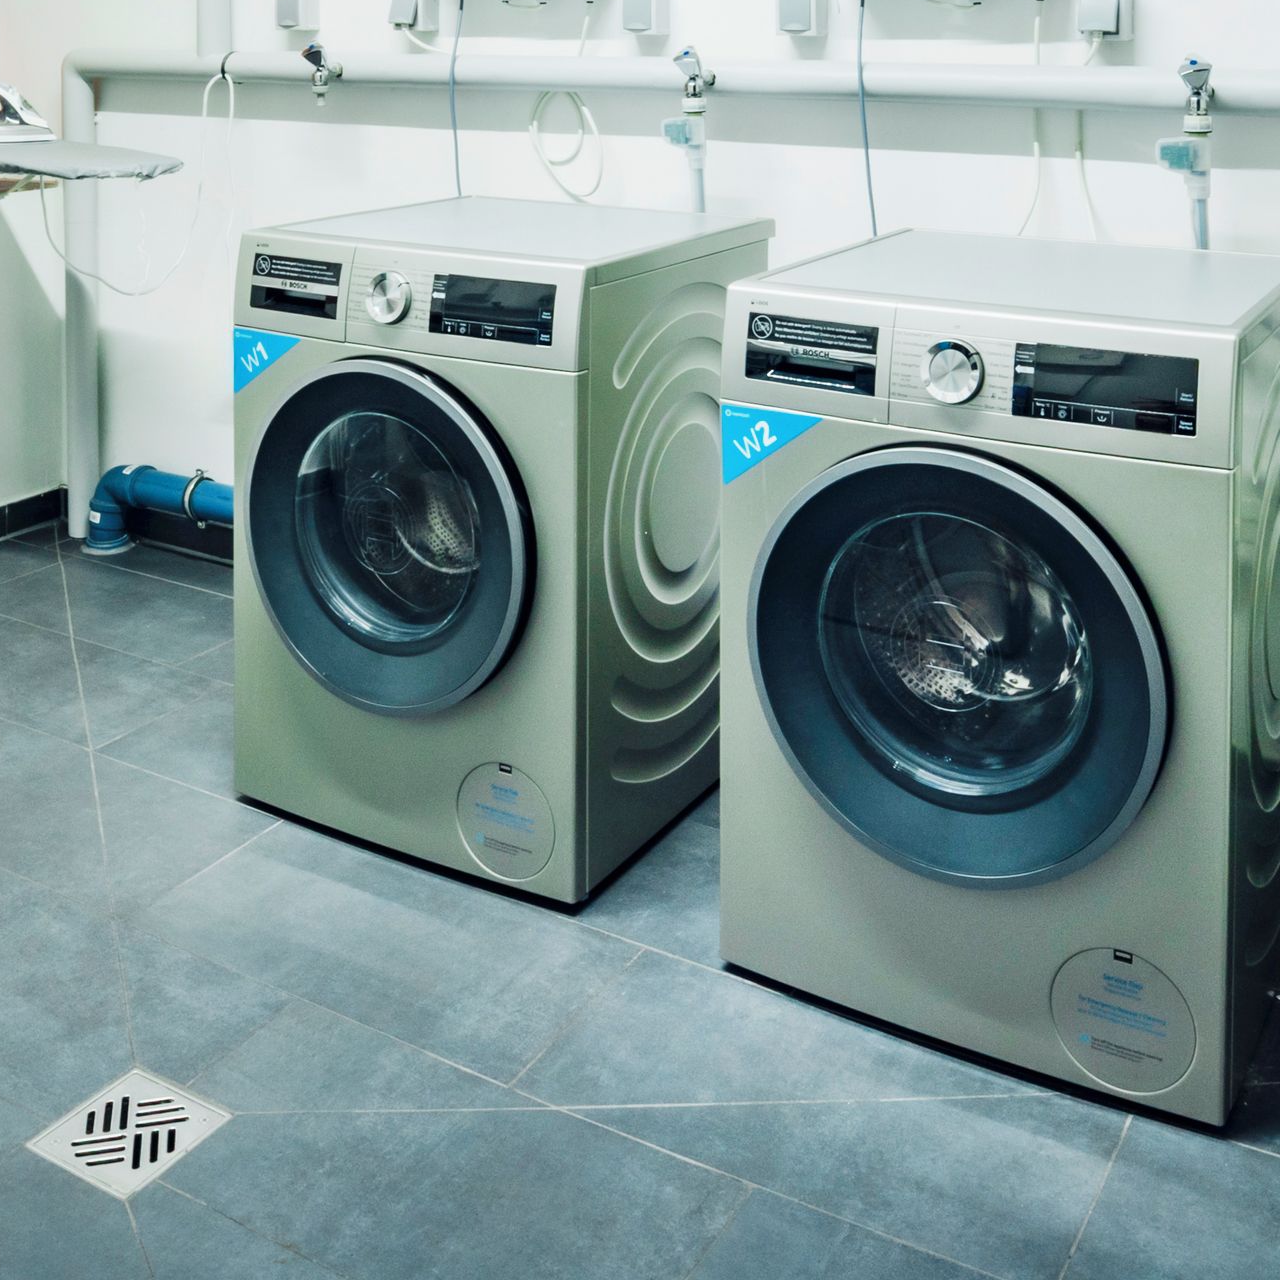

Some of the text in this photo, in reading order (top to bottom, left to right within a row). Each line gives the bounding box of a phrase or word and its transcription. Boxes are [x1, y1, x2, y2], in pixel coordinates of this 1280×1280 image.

[240, 342, 268, 373] W1
[802, 349, 830, 359] BOSCH
[733, 421, 777, 459] W2
